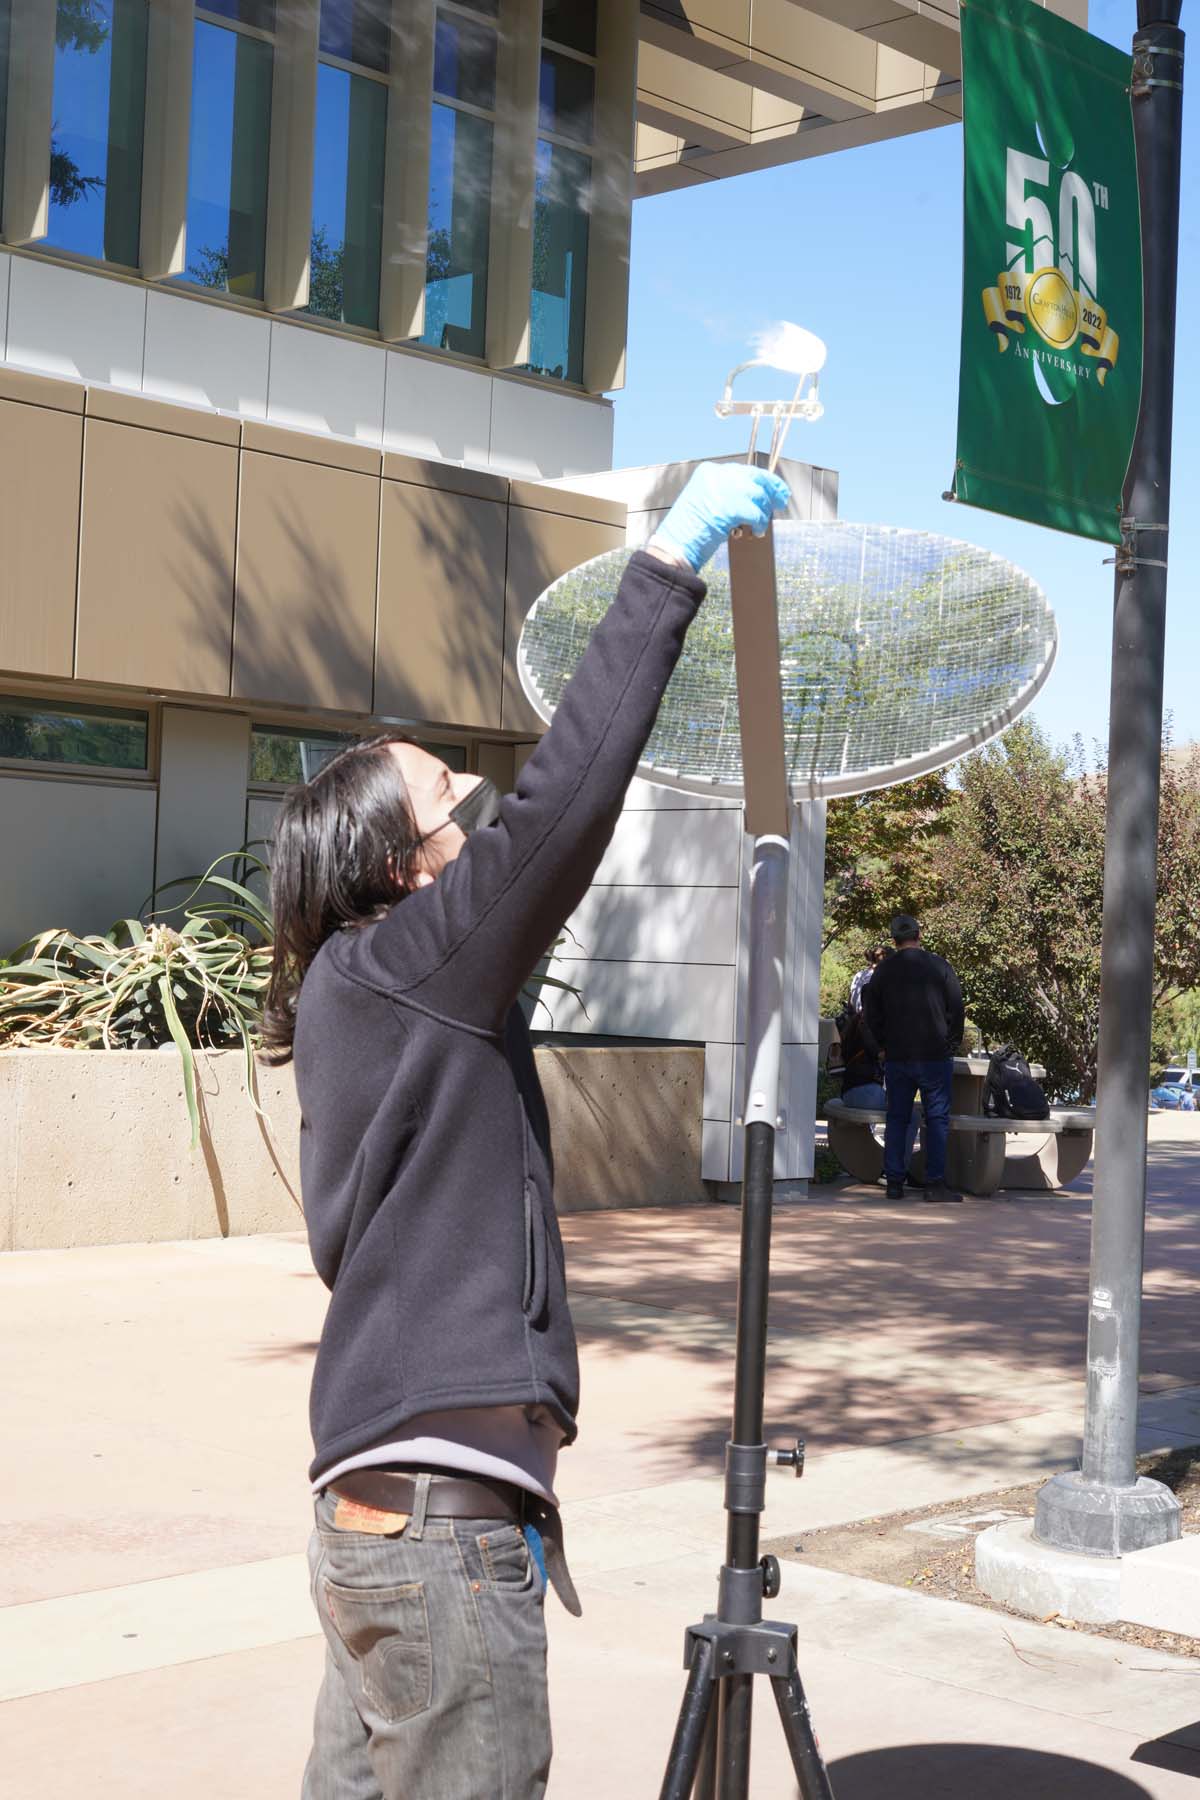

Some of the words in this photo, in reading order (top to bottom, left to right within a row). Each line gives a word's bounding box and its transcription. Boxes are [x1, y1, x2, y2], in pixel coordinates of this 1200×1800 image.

[1005, 285, 1022, 301] 1972
[1082, 308, 1103, 330] 2022
[1014, 340, 1091, 379] ANNIVERSARY
